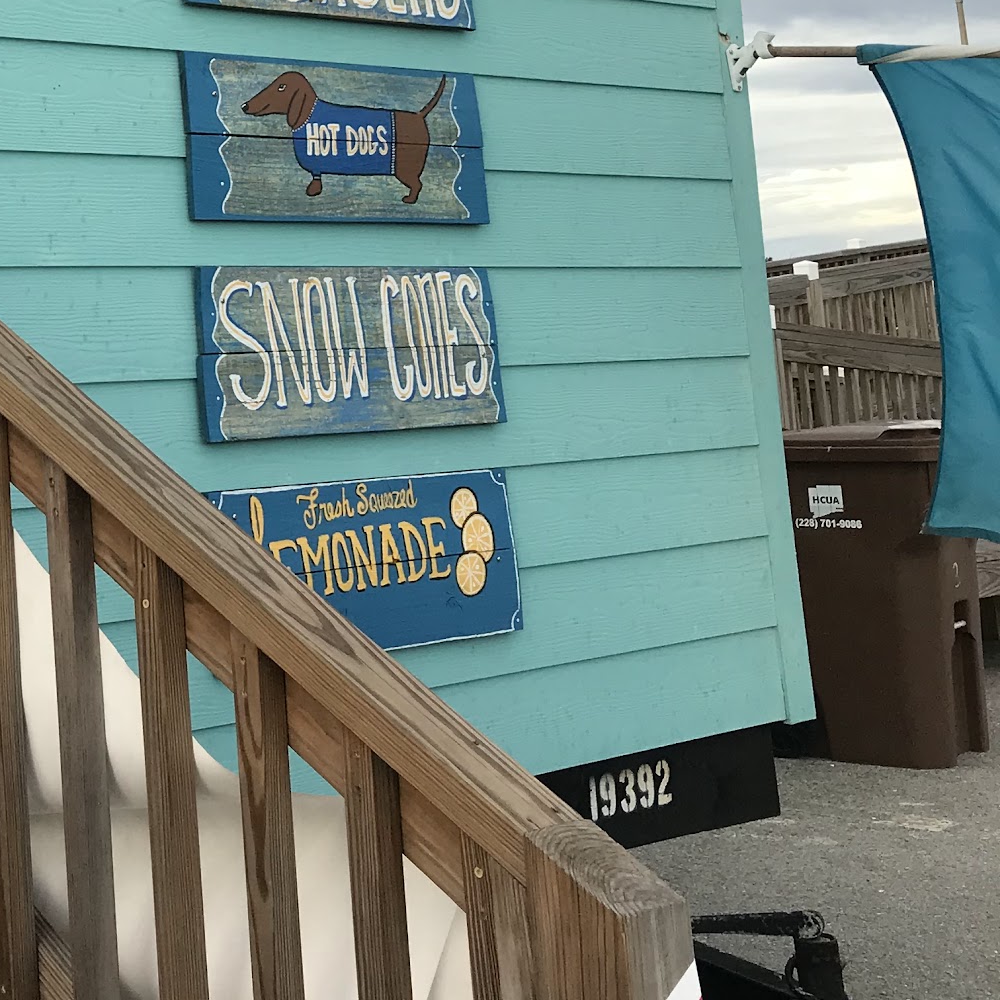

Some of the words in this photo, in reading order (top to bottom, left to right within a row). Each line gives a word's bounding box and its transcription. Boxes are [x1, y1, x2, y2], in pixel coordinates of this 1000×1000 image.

[306, 123, 340, 157] HOT
[345, 124, 389, 156] DOGS
[219, 276, 369, 411] SNOW
[296, 487, 354, 530] Fresh
[812, 496, 840, 505] HCUA
[795, 517, 818, 530] (228)
[588, 759, 673, 822] 19392
